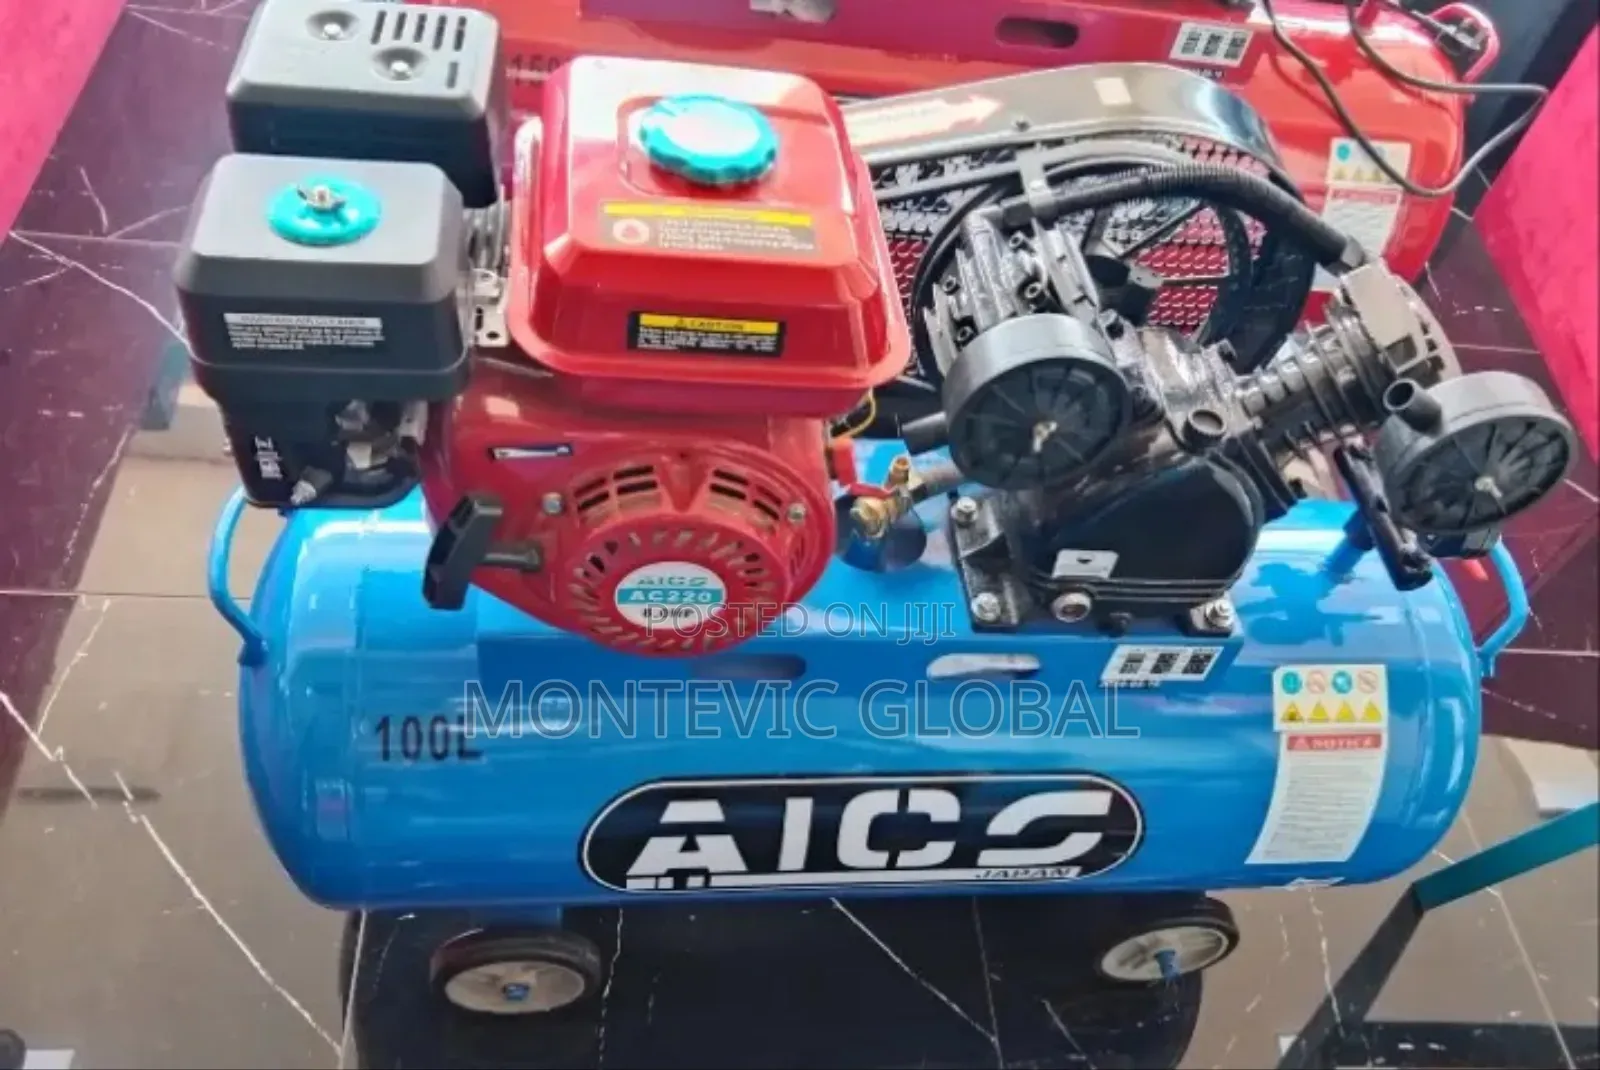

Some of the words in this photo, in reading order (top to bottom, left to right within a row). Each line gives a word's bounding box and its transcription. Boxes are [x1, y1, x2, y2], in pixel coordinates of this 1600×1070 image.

[628, 590, 713, 602] AC220
[375, 715, 484, 762] 100L
[625, 789, 1113, 877] AICS
[975, 867, 1072, 879] JAPAN
